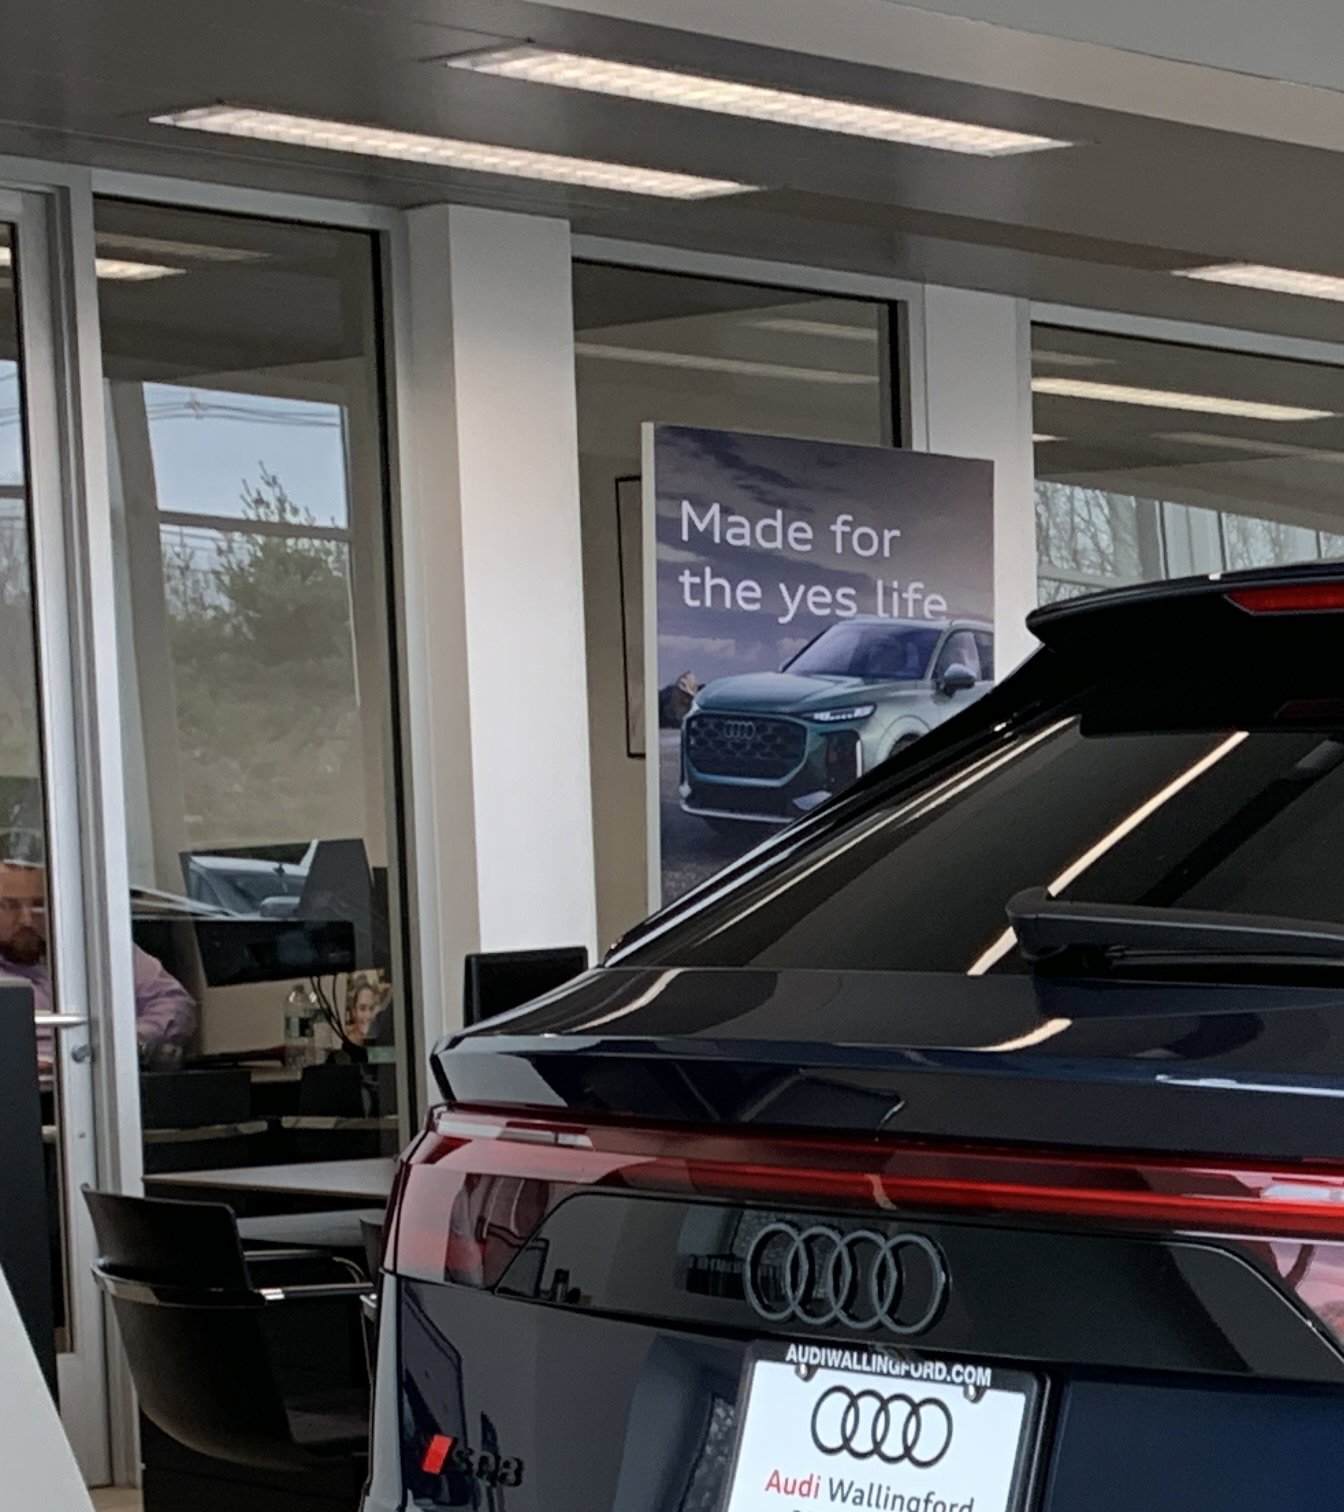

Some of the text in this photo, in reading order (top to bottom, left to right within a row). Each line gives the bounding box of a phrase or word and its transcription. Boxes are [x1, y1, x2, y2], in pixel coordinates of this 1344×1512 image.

[680, 500, 900, 558] Made for
[678, 566, 947, 624] the yes life
[785, 1344, 992, 1387] AUDIWALLINGFORD.COM
[764, 1469, 822, 1500] Audi
